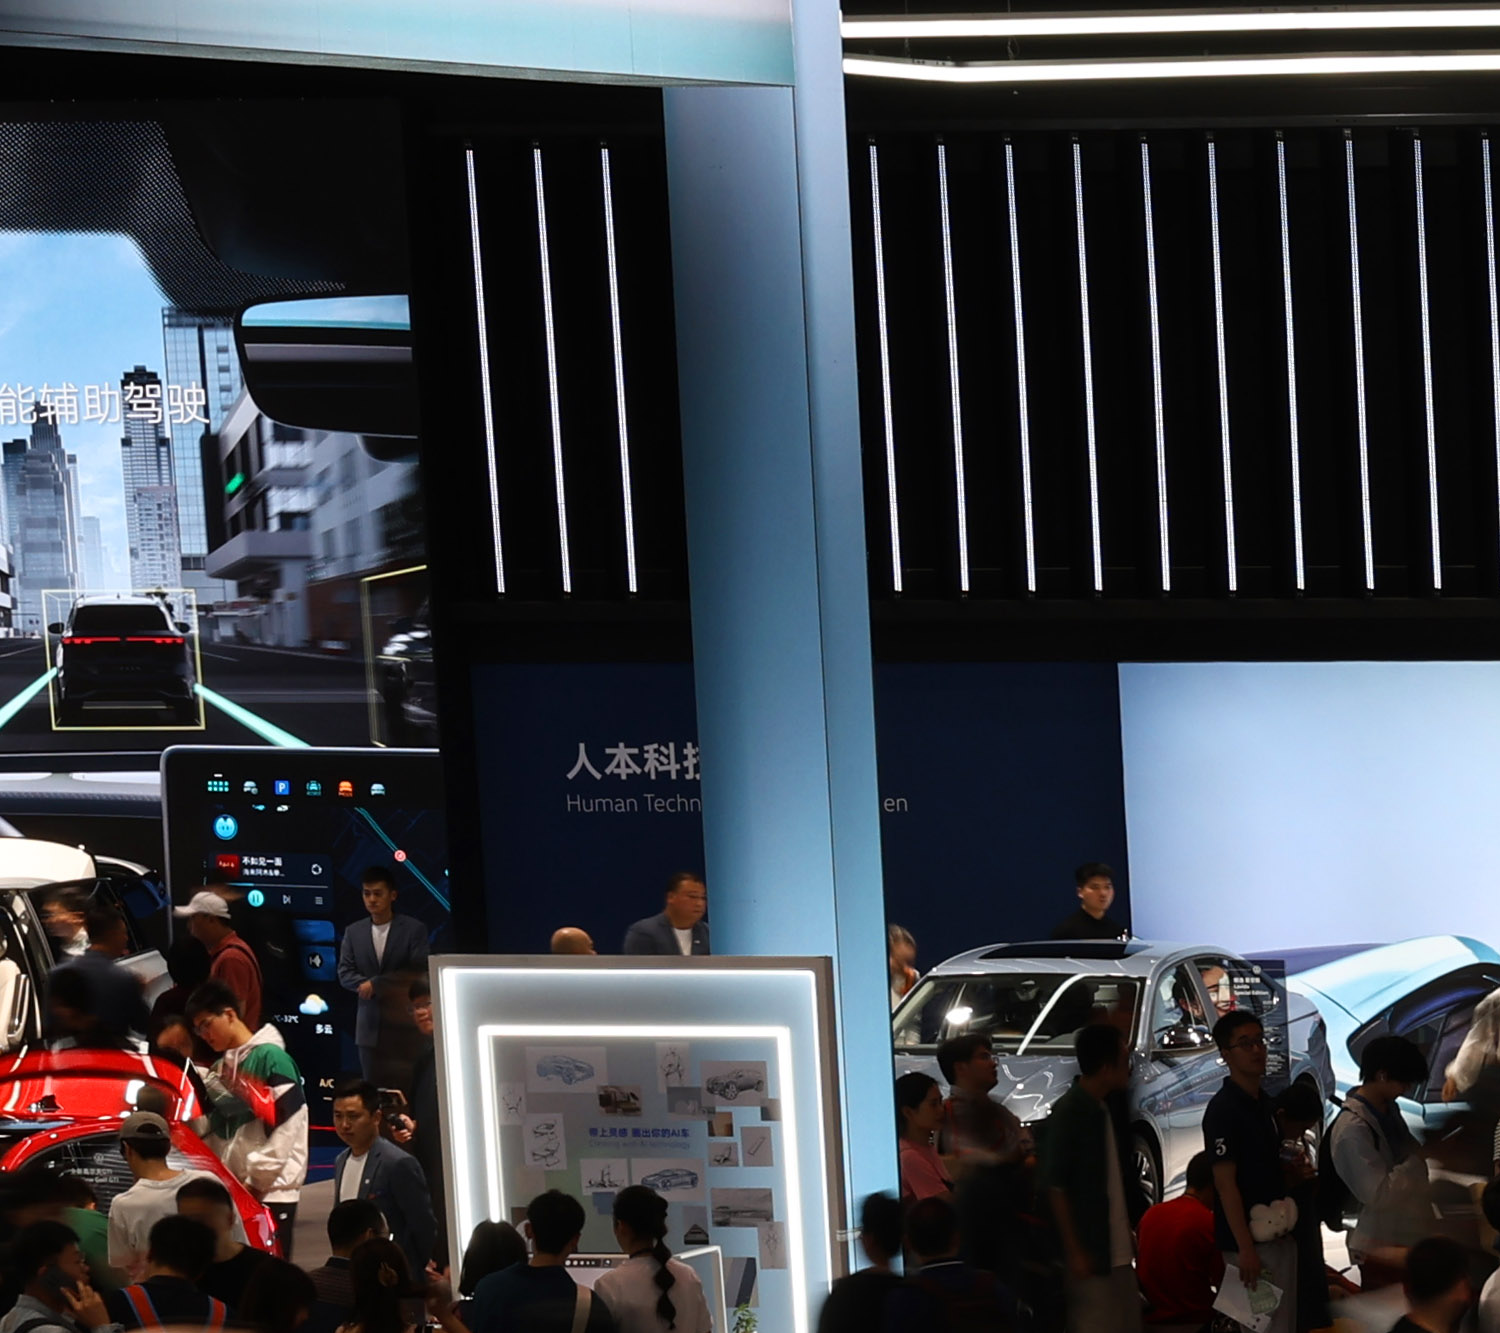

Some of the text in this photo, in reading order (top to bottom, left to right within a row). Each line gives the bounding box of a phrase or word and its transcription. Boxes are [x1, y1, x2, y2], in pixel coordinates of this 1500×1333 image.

[0, 382, 210, 425] 能辅助驾驶
[566, 794, 638, 813] Human
[1215, 1137, 1227, 1155] 3
